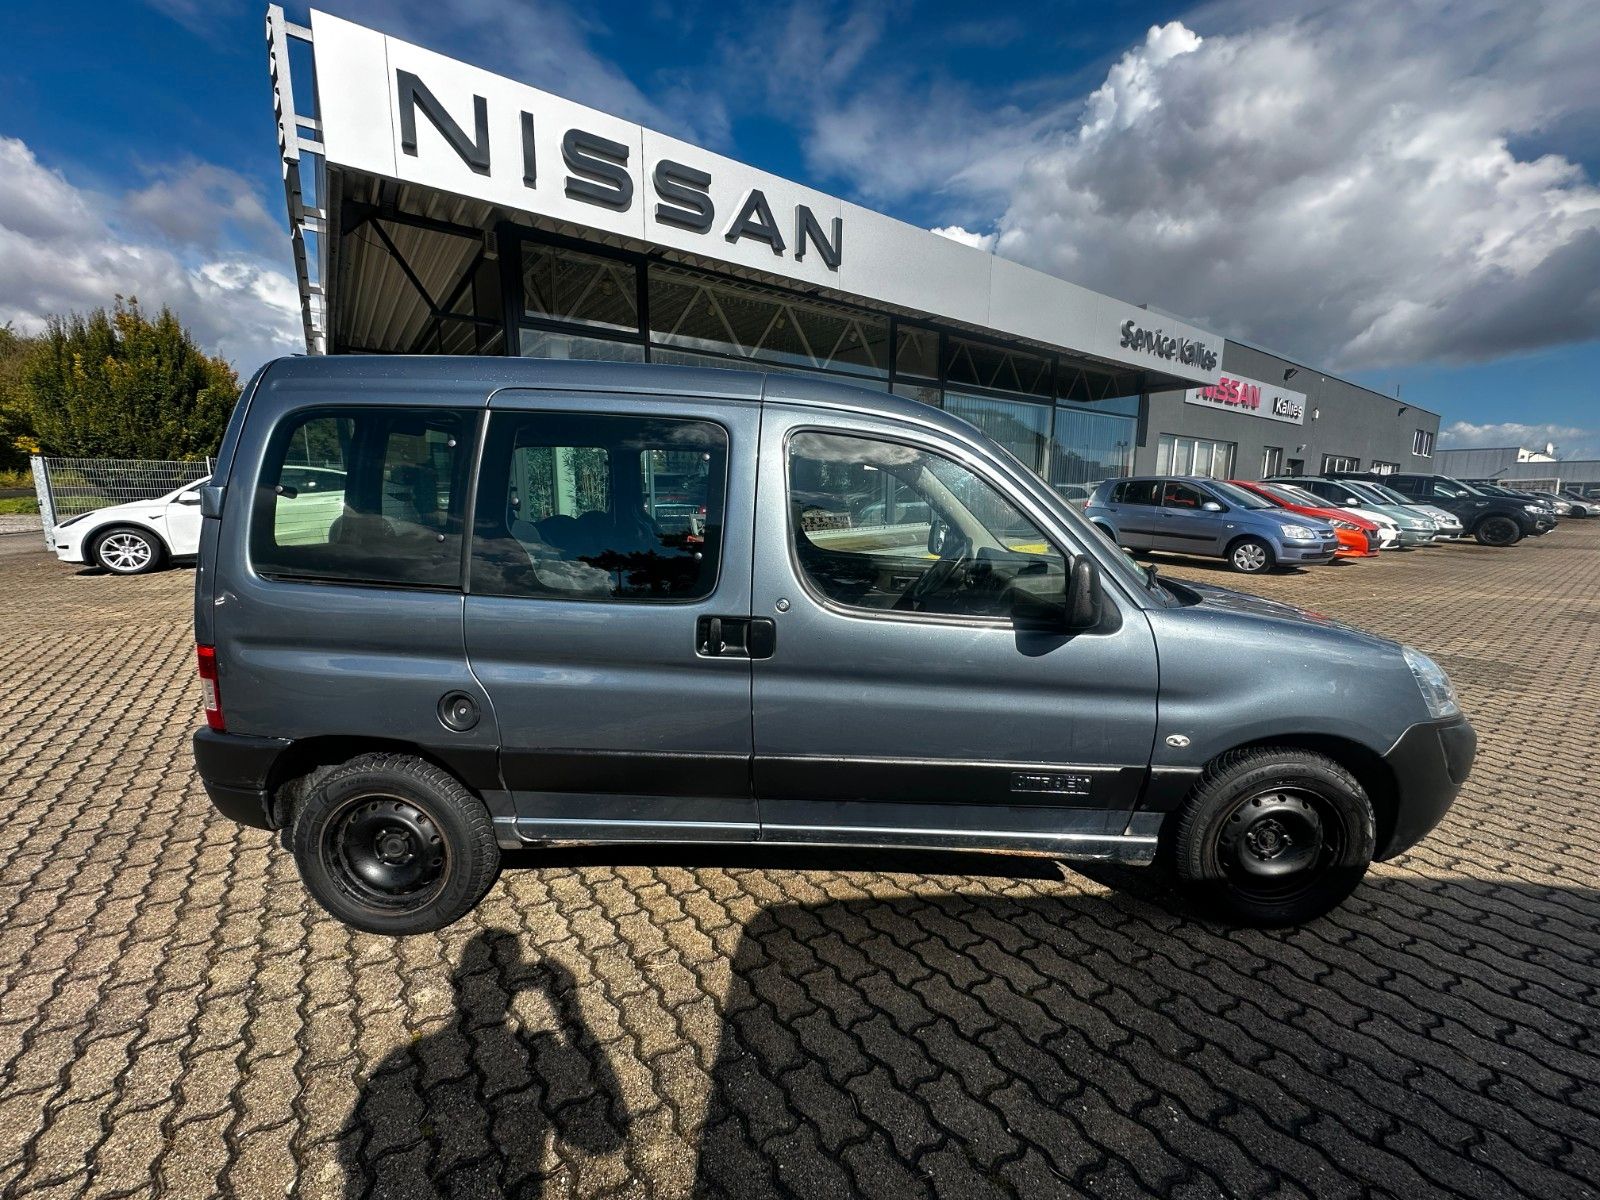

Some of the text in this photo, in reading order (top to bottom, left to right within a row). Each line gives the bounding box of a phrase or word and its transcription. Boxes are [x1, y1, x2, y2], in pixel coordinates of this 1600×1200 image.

[395, 68, 843, 272] NISSAN
[1120, 320, 1218, 371] Service Kallies
[1273, 397, 1303, 419] Kallies
